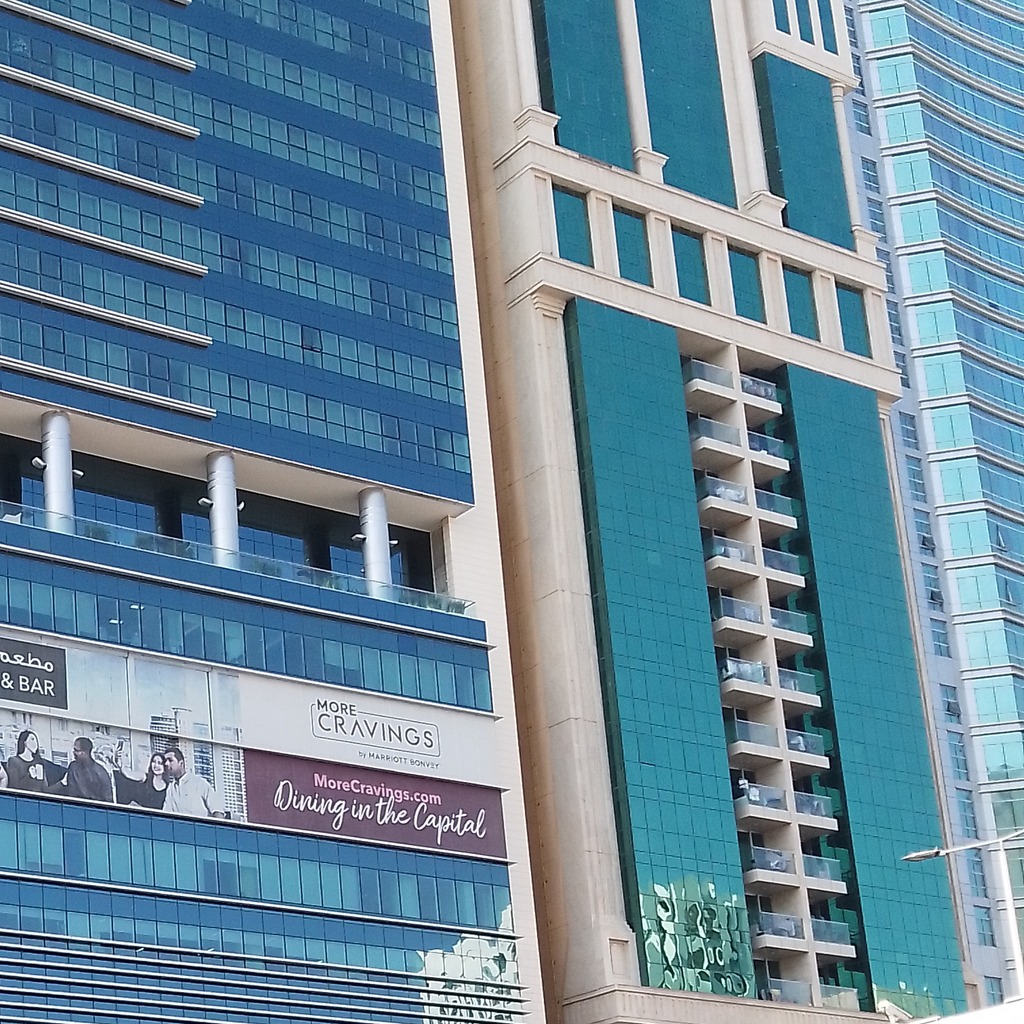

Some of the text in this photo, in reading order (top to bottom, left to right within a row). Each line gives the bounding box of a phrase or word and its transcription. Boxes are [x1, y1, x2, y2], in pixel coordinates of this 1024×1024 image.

[1, 672, 15, 690] &
[19, 677, 56, 697] BAR
[317, 698, 357, 716] MORE
[318, 713, 434, 749] CRAVINGS
[358, 750, 367, 759] by
[368, 752, 408, 764] MARRIOTT
[314, 772, 442, 806] MoreCravings.com
[273, 779, 487, 846] Dining in the Capital
